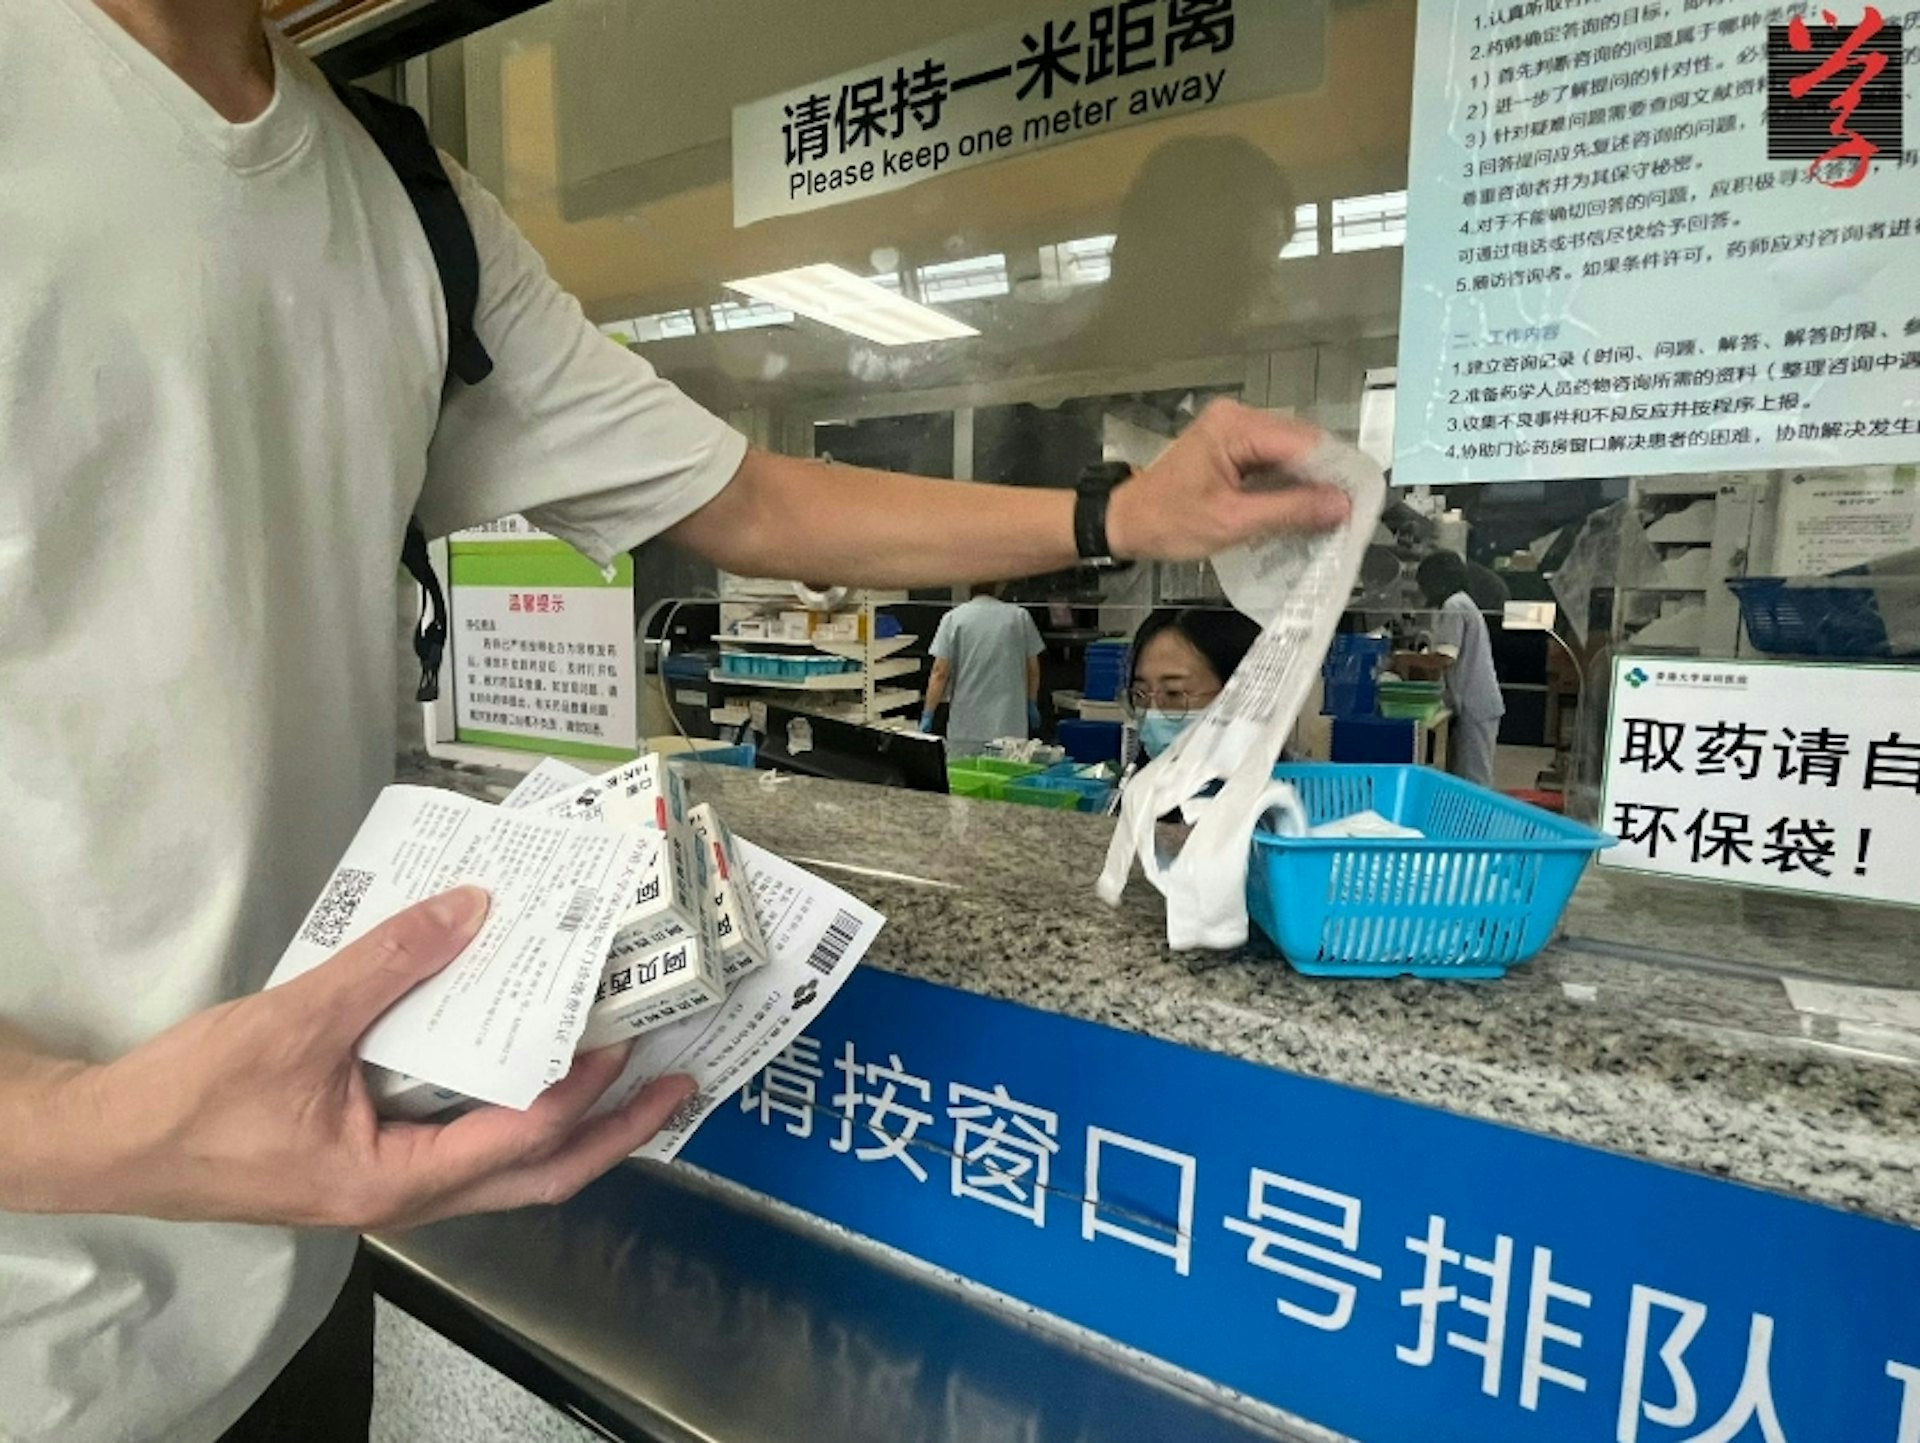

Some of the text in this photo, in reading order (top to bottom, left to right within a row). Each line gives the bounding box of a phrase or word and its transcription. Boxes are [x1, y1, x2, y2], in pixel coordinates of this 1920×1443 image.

[782, 0, 1236, 167] 请保持一米距离
[789, 69, 1226, 200] Please keep one meter away
[1445, 417, 1920, 460] 4.协助门诊药房窗口解决患者的困难，协助解决发生
[1620, 718, 1920, 795] 取药请自
[740, 1035, 1920, 1443] 请按窗口号排队
